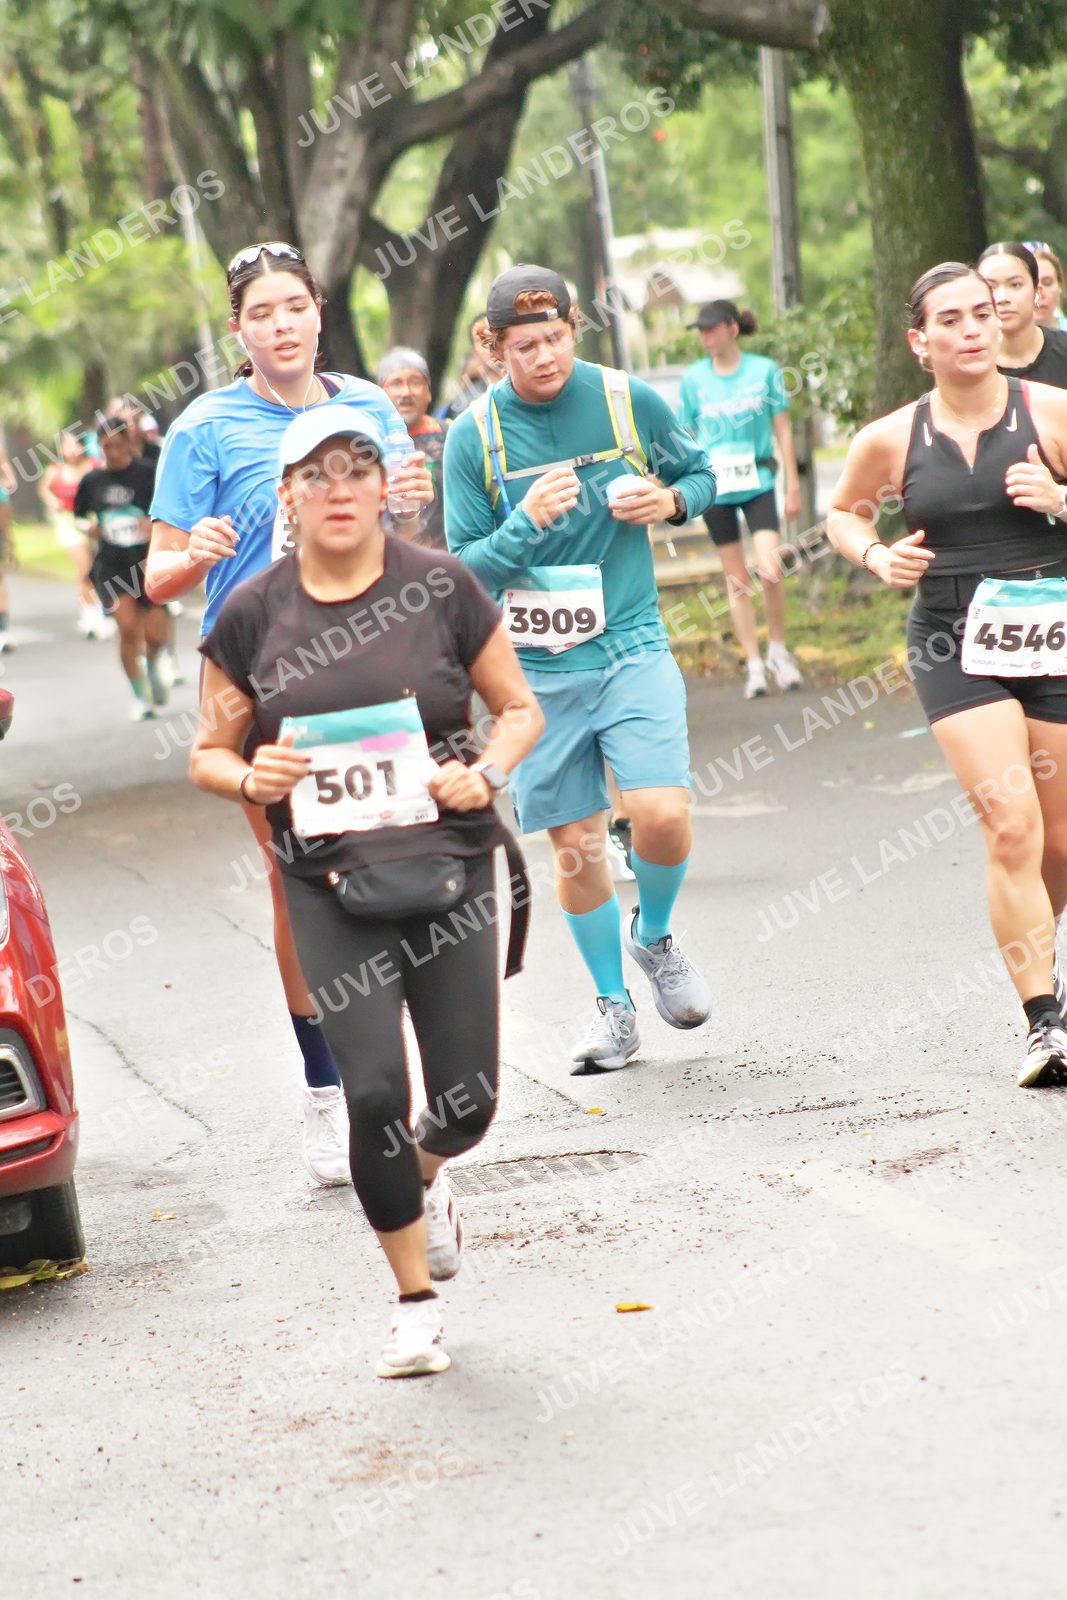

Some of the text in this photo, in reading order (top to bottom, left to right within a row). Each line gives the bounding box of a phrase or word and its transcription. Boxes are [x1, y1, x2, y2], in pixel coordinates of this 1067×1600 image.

[509, 606, 597, 635] 3909
[973, 621, 1066, 653] 4546
[315, 760, 398, 805] 501
